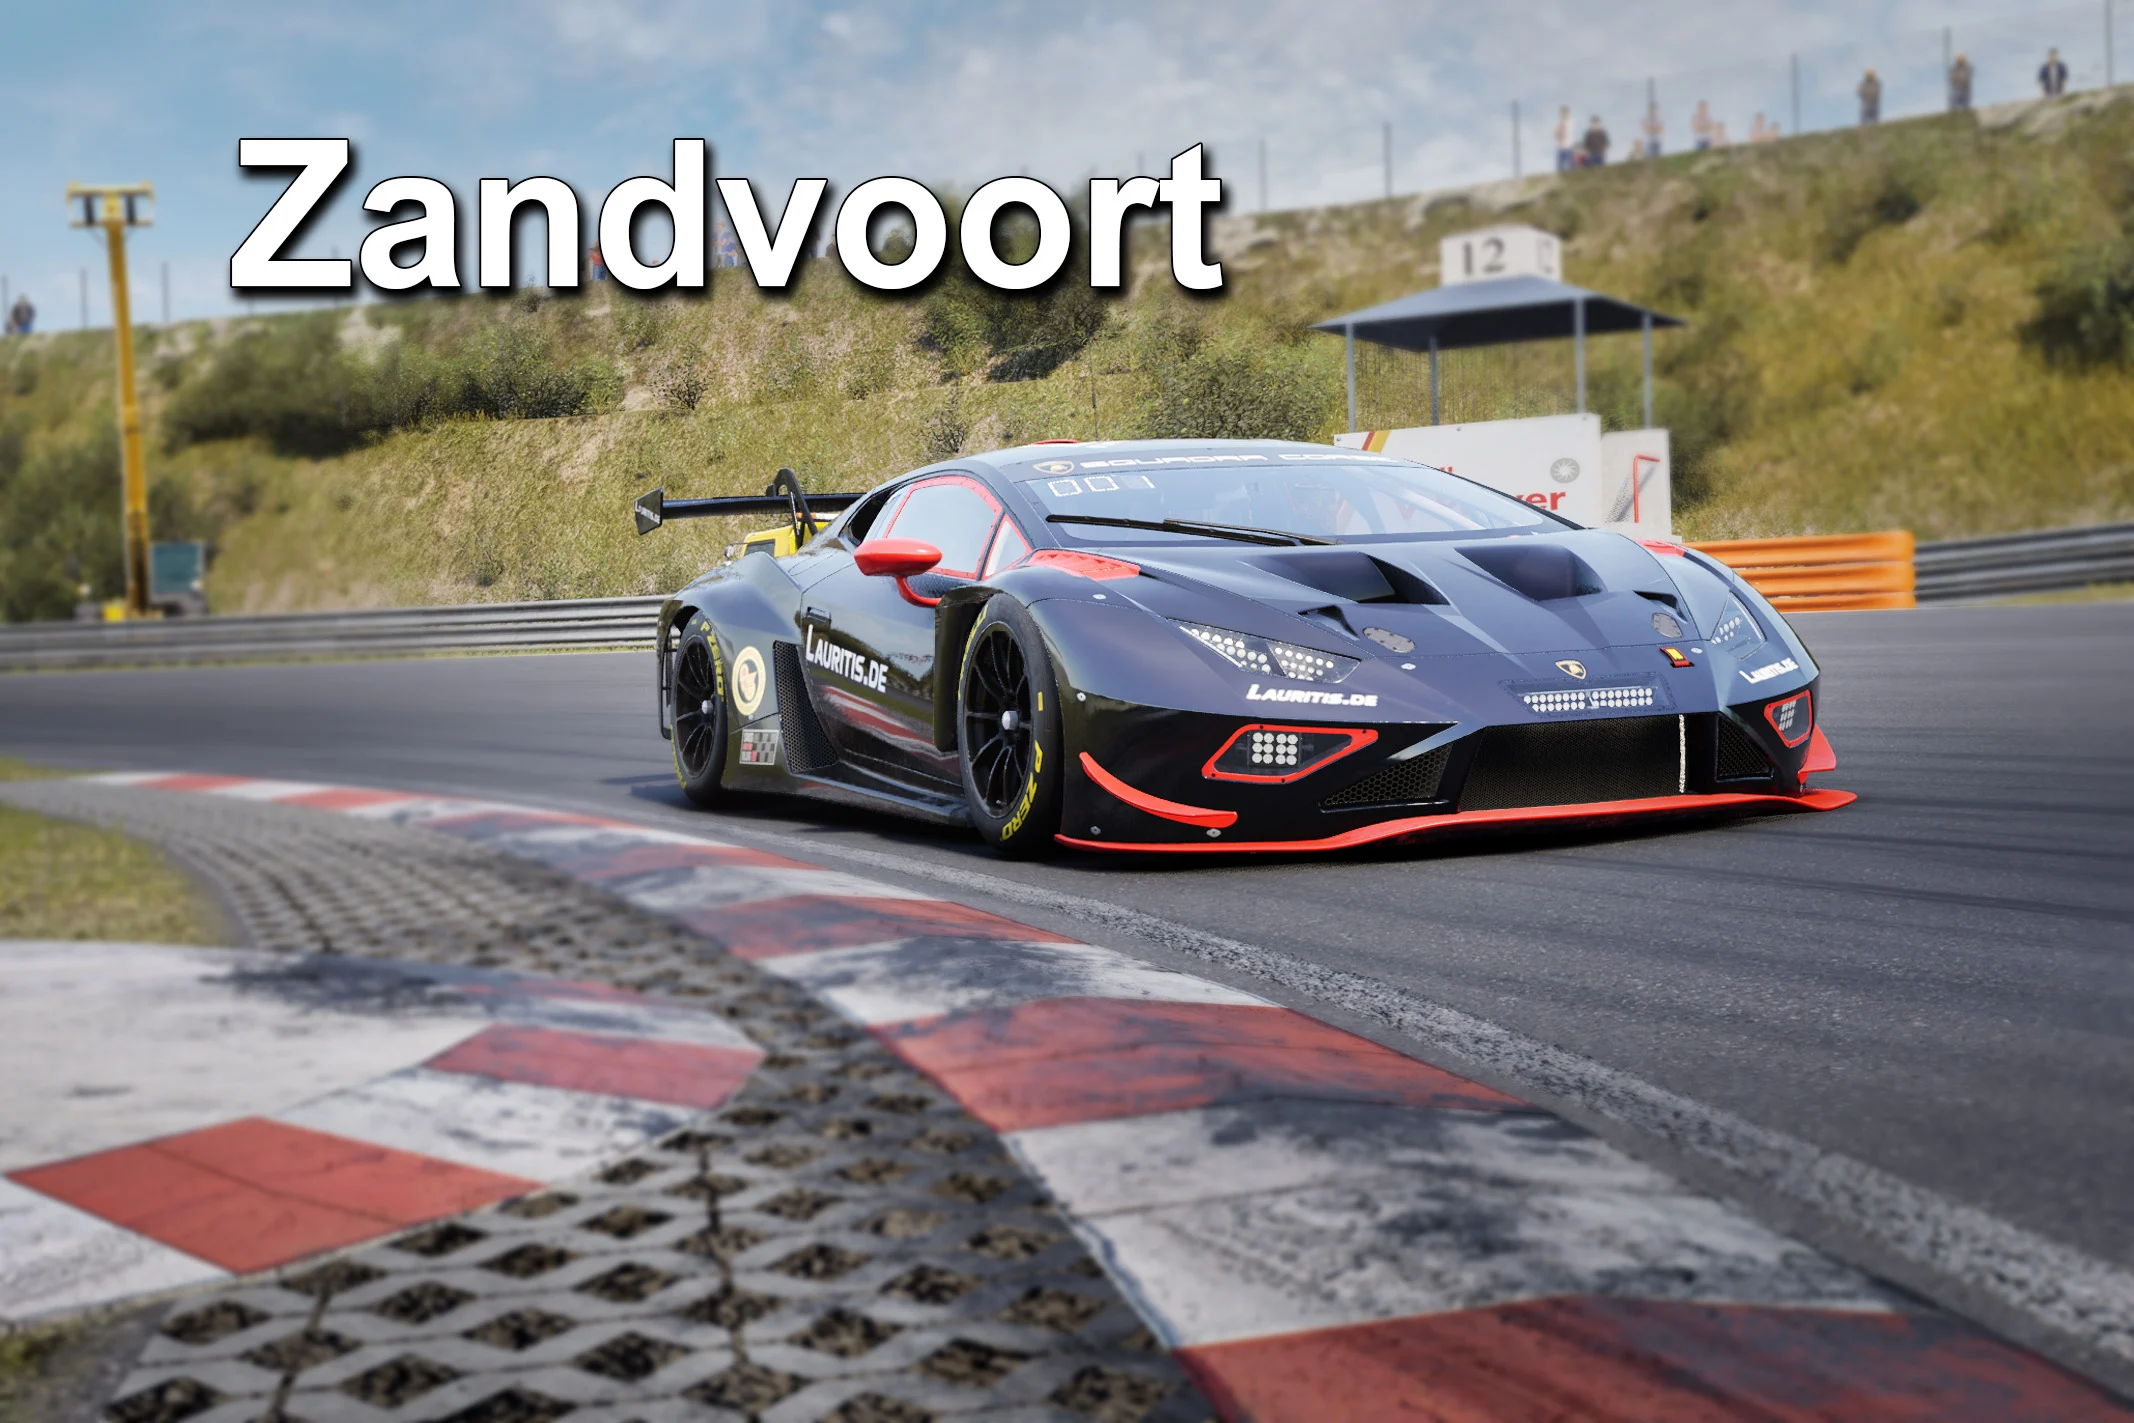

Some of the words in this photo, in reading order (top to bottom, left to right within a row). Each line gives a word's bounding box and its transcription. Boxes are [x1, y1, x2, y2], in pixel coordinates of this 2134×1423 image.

[1463, 237, 1506, 277] 12
[806, 624, 889, 693] LAURITIS.DE
[1245, 683, 1379, 707] LAURITIS.DE
[1000, 771, 1038, 842] ZERO
